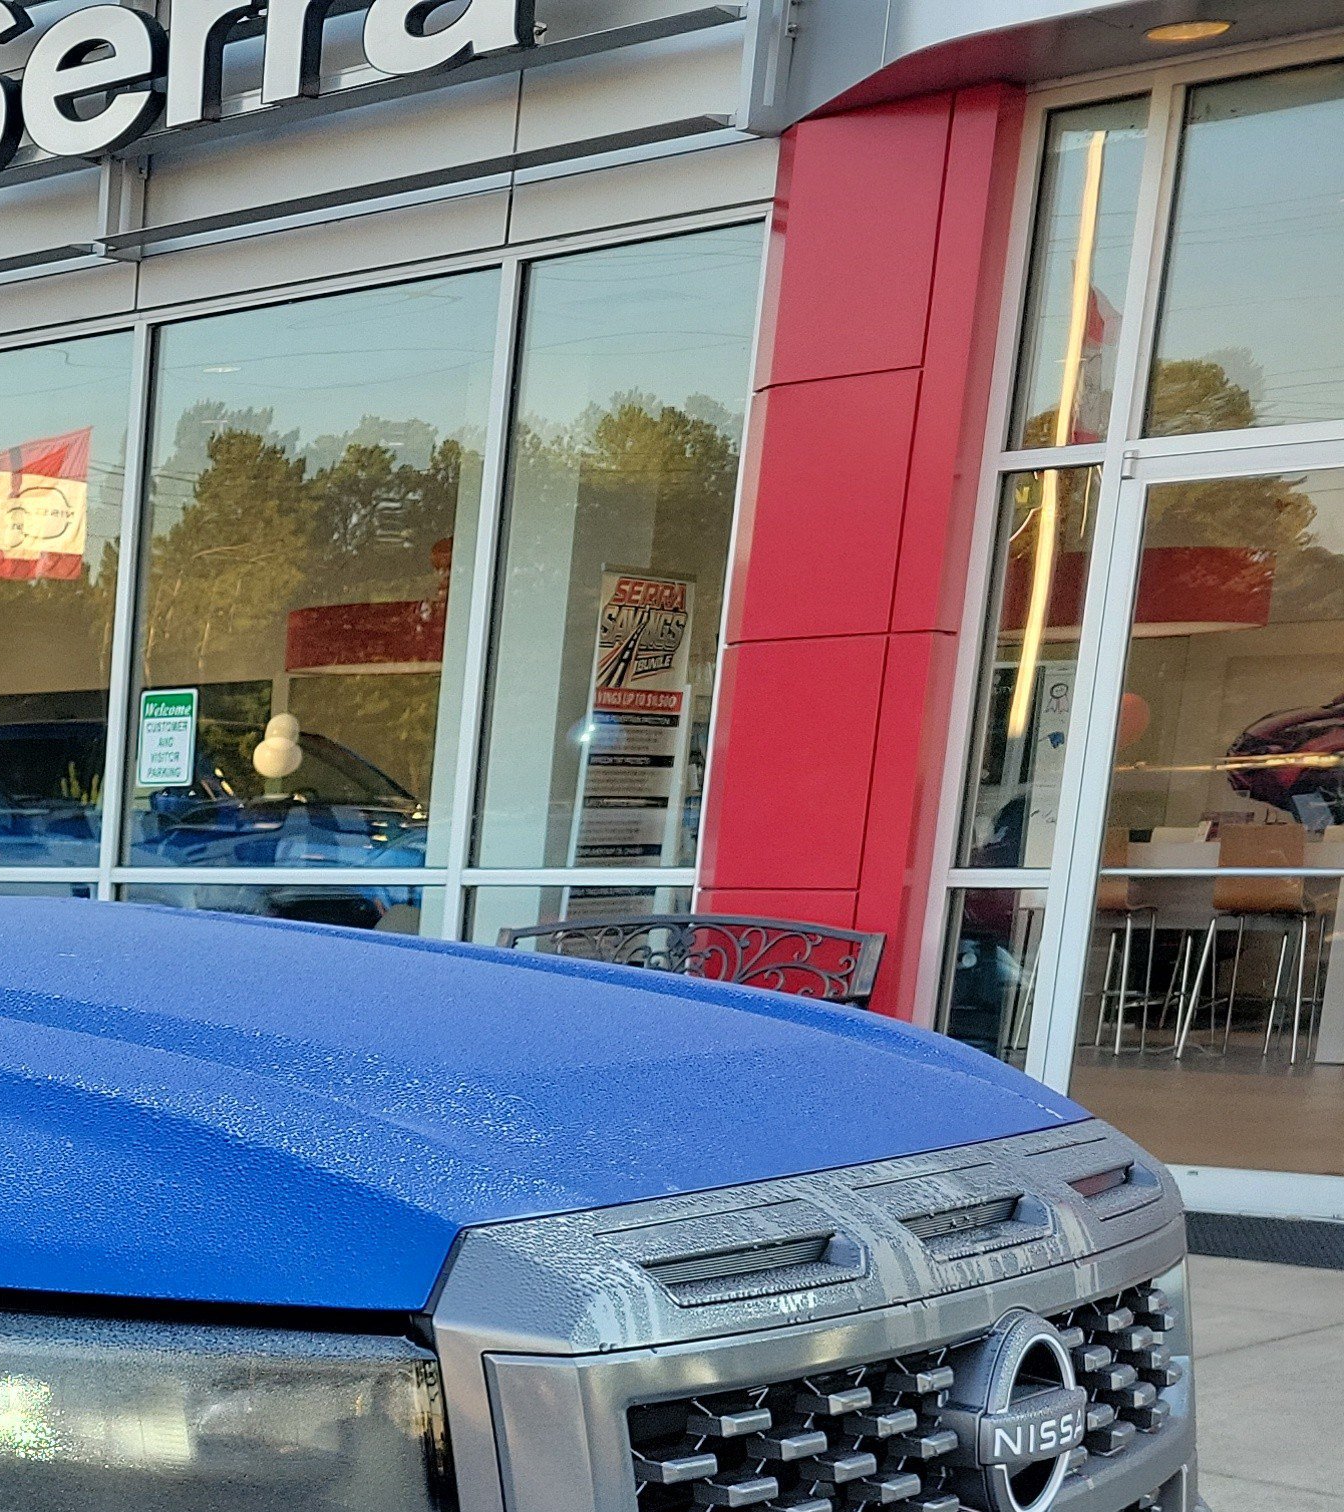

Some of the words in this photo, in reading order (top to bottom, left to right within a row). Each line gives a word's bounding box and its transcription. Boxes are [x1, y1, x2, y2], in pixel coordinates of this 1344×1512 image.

[612, 577, 687, 611] SERRA
[145, 702, 192, 717] Welcome
[158, 736, 174, 748] AND
[994, 1408, 1082, 1457] NISSA
